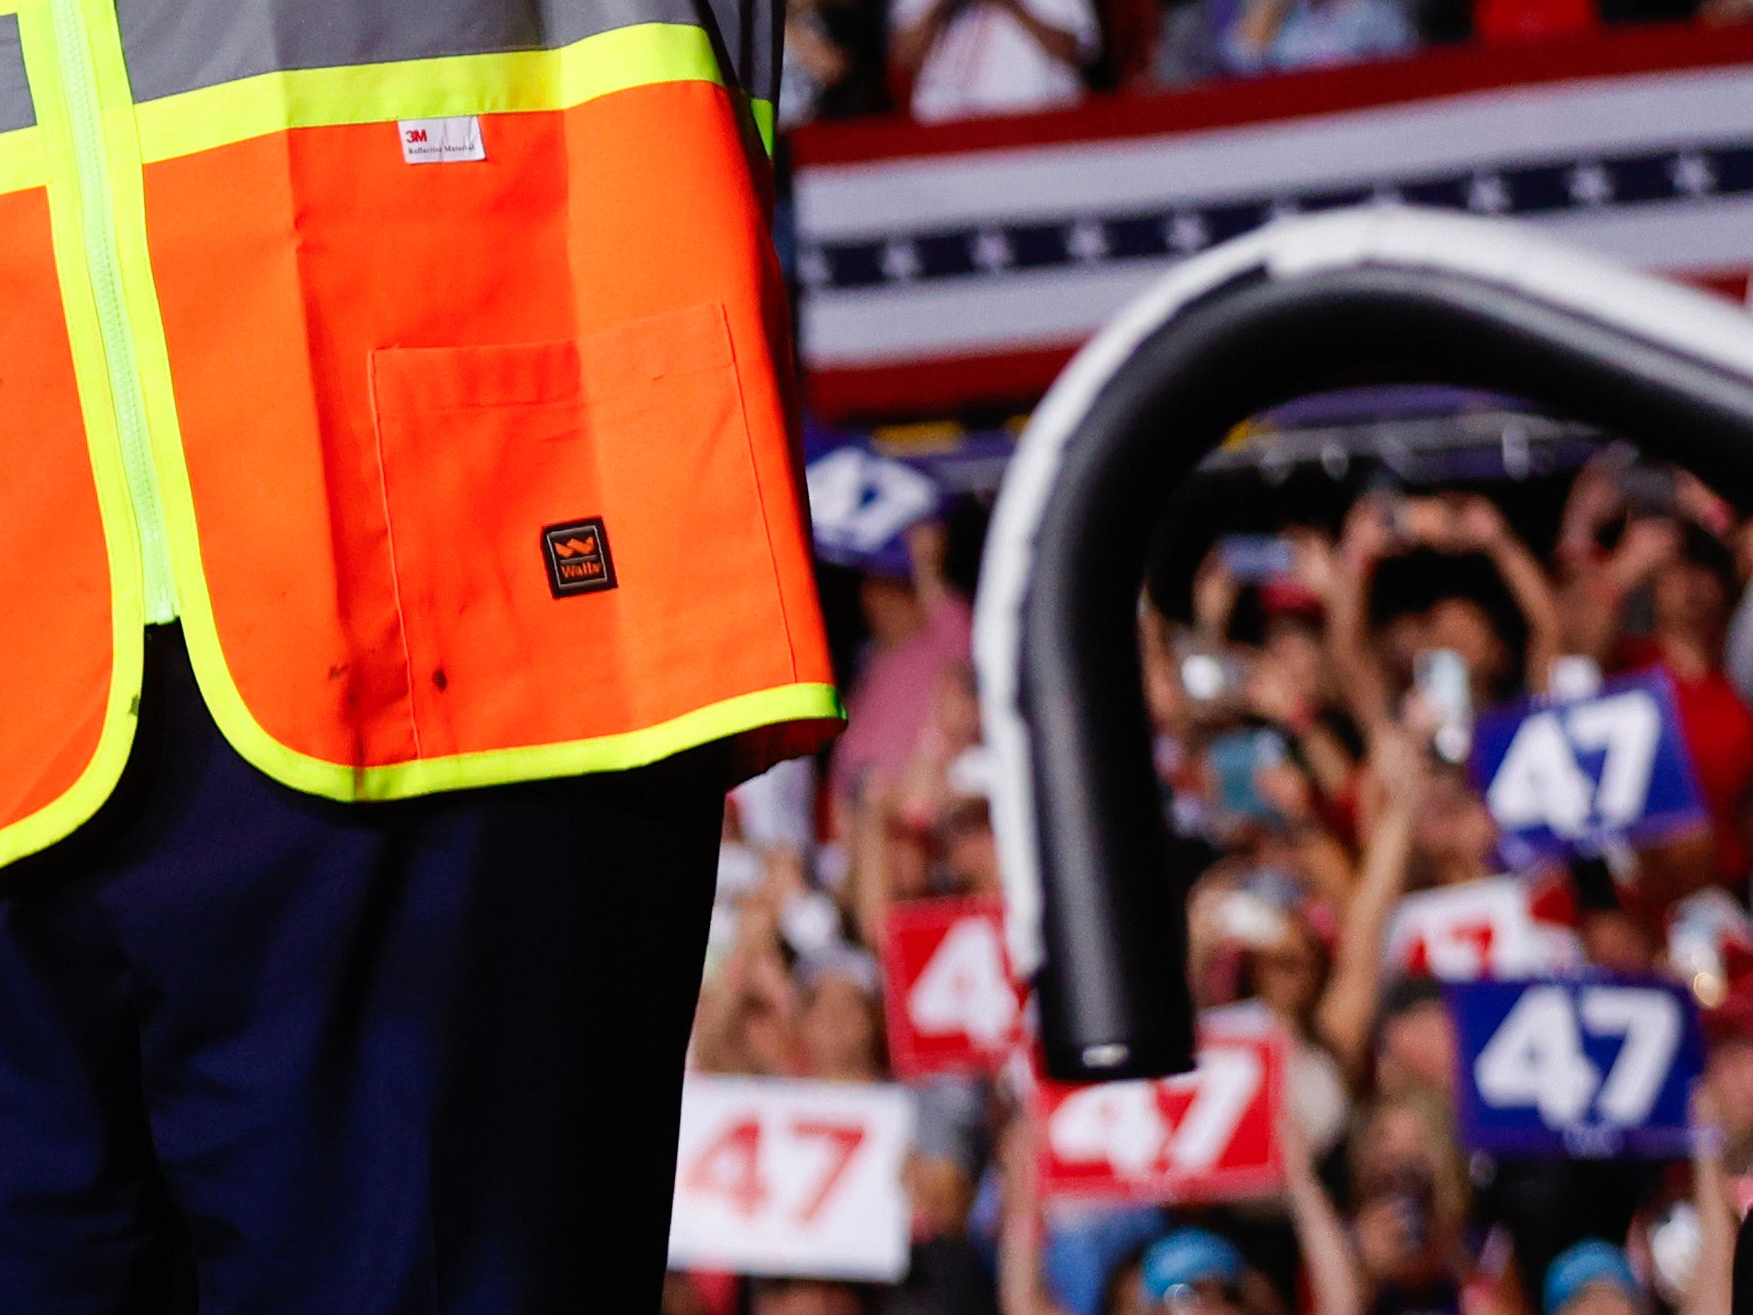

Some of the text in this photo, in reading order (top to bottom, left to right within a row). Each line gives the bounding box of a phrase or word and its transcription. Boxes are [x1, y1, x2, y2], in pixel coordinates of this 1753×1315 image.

[405, 129, 427, 143] 3M
[805, 446, 941, 552] 47
[560, 561, 603, 579] Walls
[1487, 688, 1661, 842] 47
[1474, 985, 1683, 1130] 47
[1048, 1046, 1264, 1181] 47
[685, 1118, 868, 1228] 47
